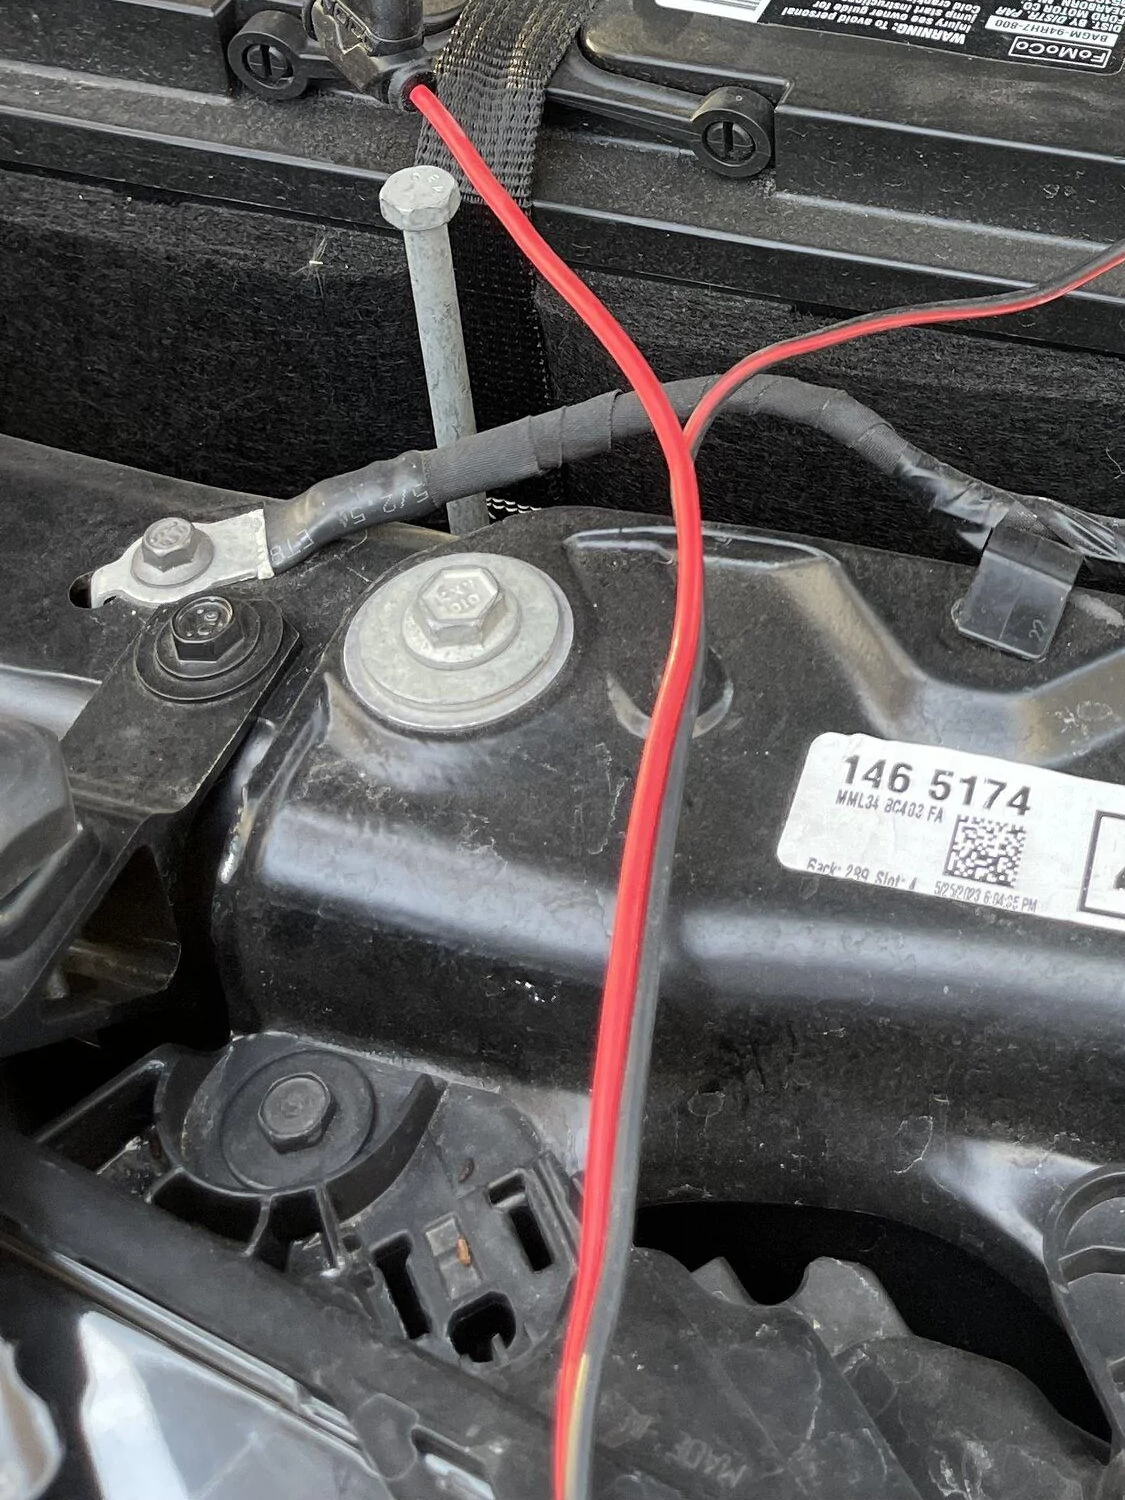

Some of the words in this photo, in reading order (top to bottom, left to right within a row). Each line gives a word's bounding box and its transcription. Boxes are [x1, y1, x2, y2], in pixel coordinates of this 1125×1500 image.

[812, 0, 831, 10] for
[833, 3, 868, 14] guide
[952, 2, 981, 14] Cold
[995, 6, 1022, 16] PAR
[1020, 1, 1041, 10] CO.
[781, 7, 837, 20] personal
[869, 9, 908, 20] owner
[914, 6, 943, 17] start
[945, 10, 977, 23] jump
[1043, 5, 1089, 19] MOTOR
[837, 14, 872, 26] avoid
[911, 15, 934, 25] see
[1092, 13, 1125, 24] FORD
[874, 20, 888, 30] To
[1092, 20, 1122, 33] DIST.
[891, 22, 965, 45] WARNING:
[843, 755, 913, 794] 146
[928, 769, 1032, 815] 5174
[927, 806, 944, 823] FA
[1021, 897, 1038, 913] PM
